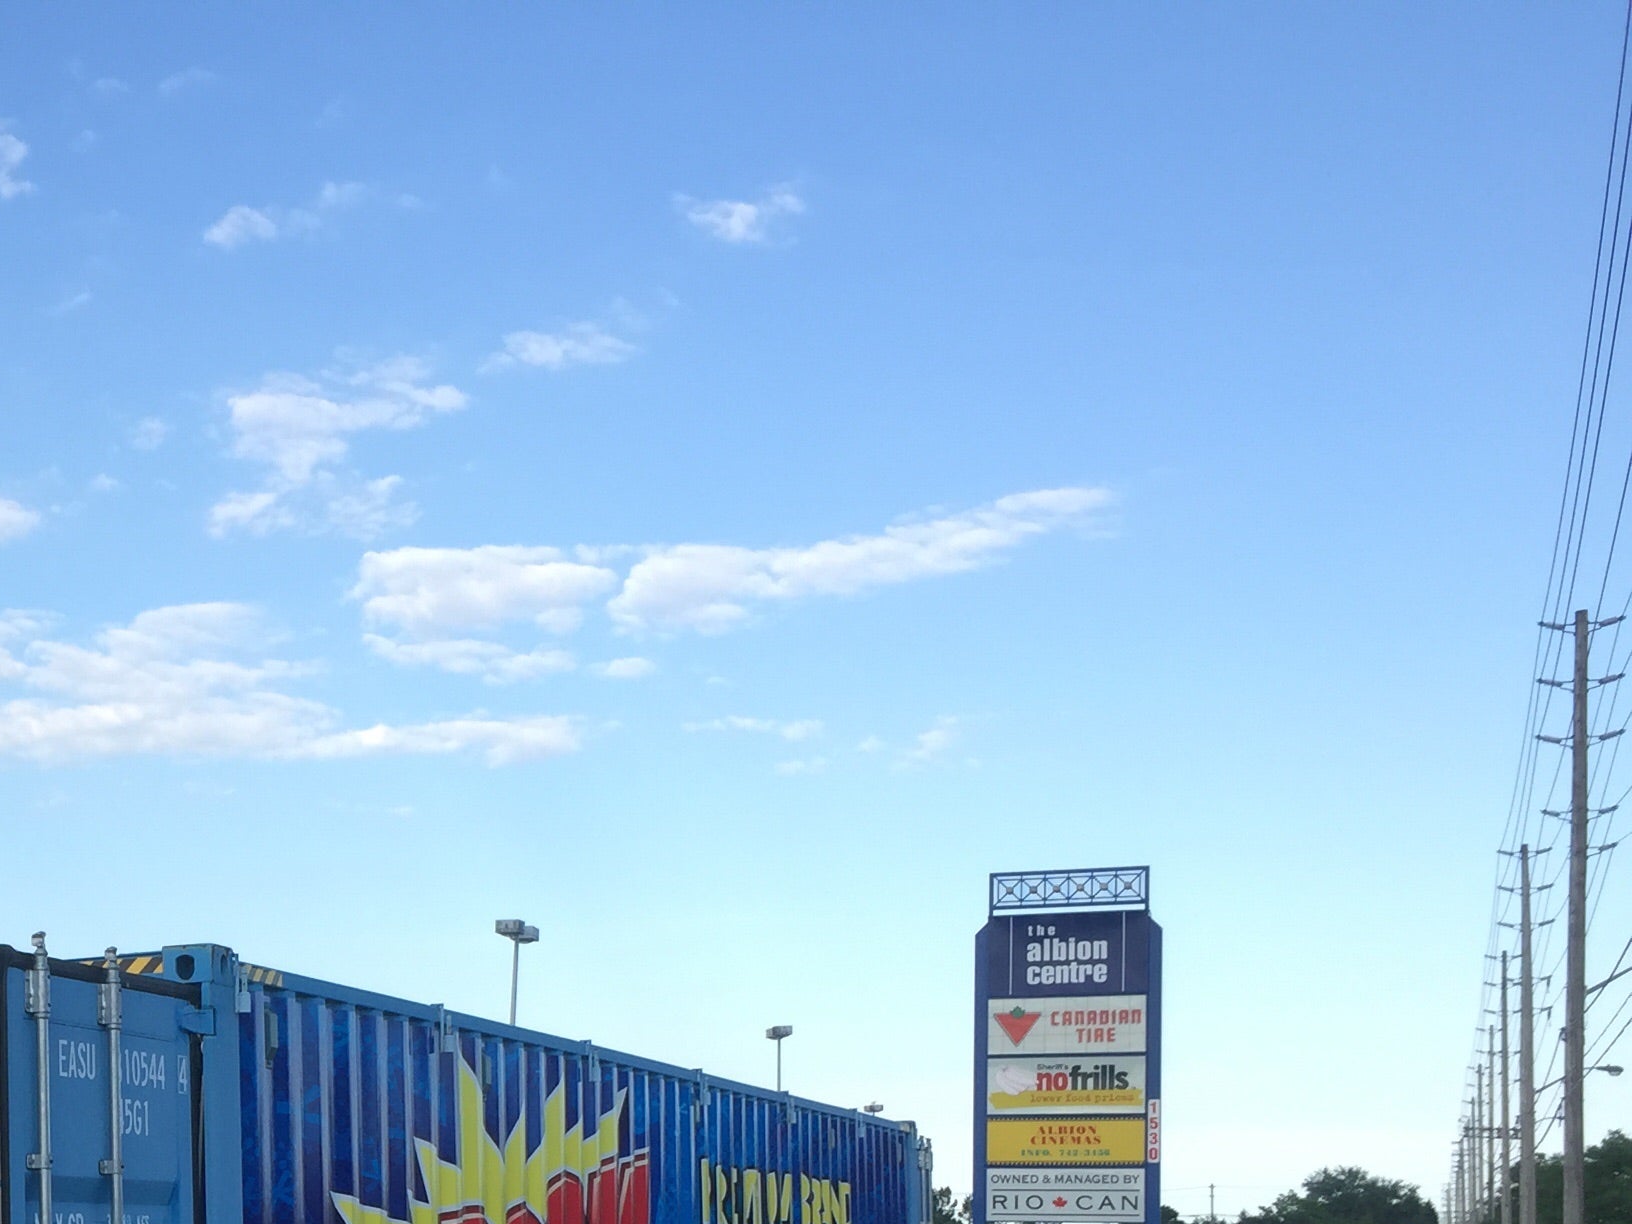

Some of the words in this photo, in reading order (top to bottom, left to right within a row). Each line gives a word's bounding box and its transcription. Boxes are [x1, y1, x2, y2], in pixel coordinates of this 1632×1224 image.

[1028, 925, 1056, 936] the
[1027, 937, 1108, 962] albion
[1027, 962, 1108, 985] centre
[1050, 1009, 1142, 1026] CANADIAN
[1076, 1028, 1116, 1043] TIRE
[58, 1039, 96, 1080] EASU
[118, 1049, 165, 1090] 10544
[1037, 1125, 1097, 1135] ALBION
[1030, 1136, 1102, 1145] CINEMAS
[990, 1174, 1039, 1184] OWNED
[1042, 1174, 1051, 1184] &
[1054, 1174, 1119, 1184] MANAGED
[1123, 1174, 1140, 1184] BY
[992, 1195, 1044, 1210] RIO
[1075, 1195, 1139, 1210] CAN
